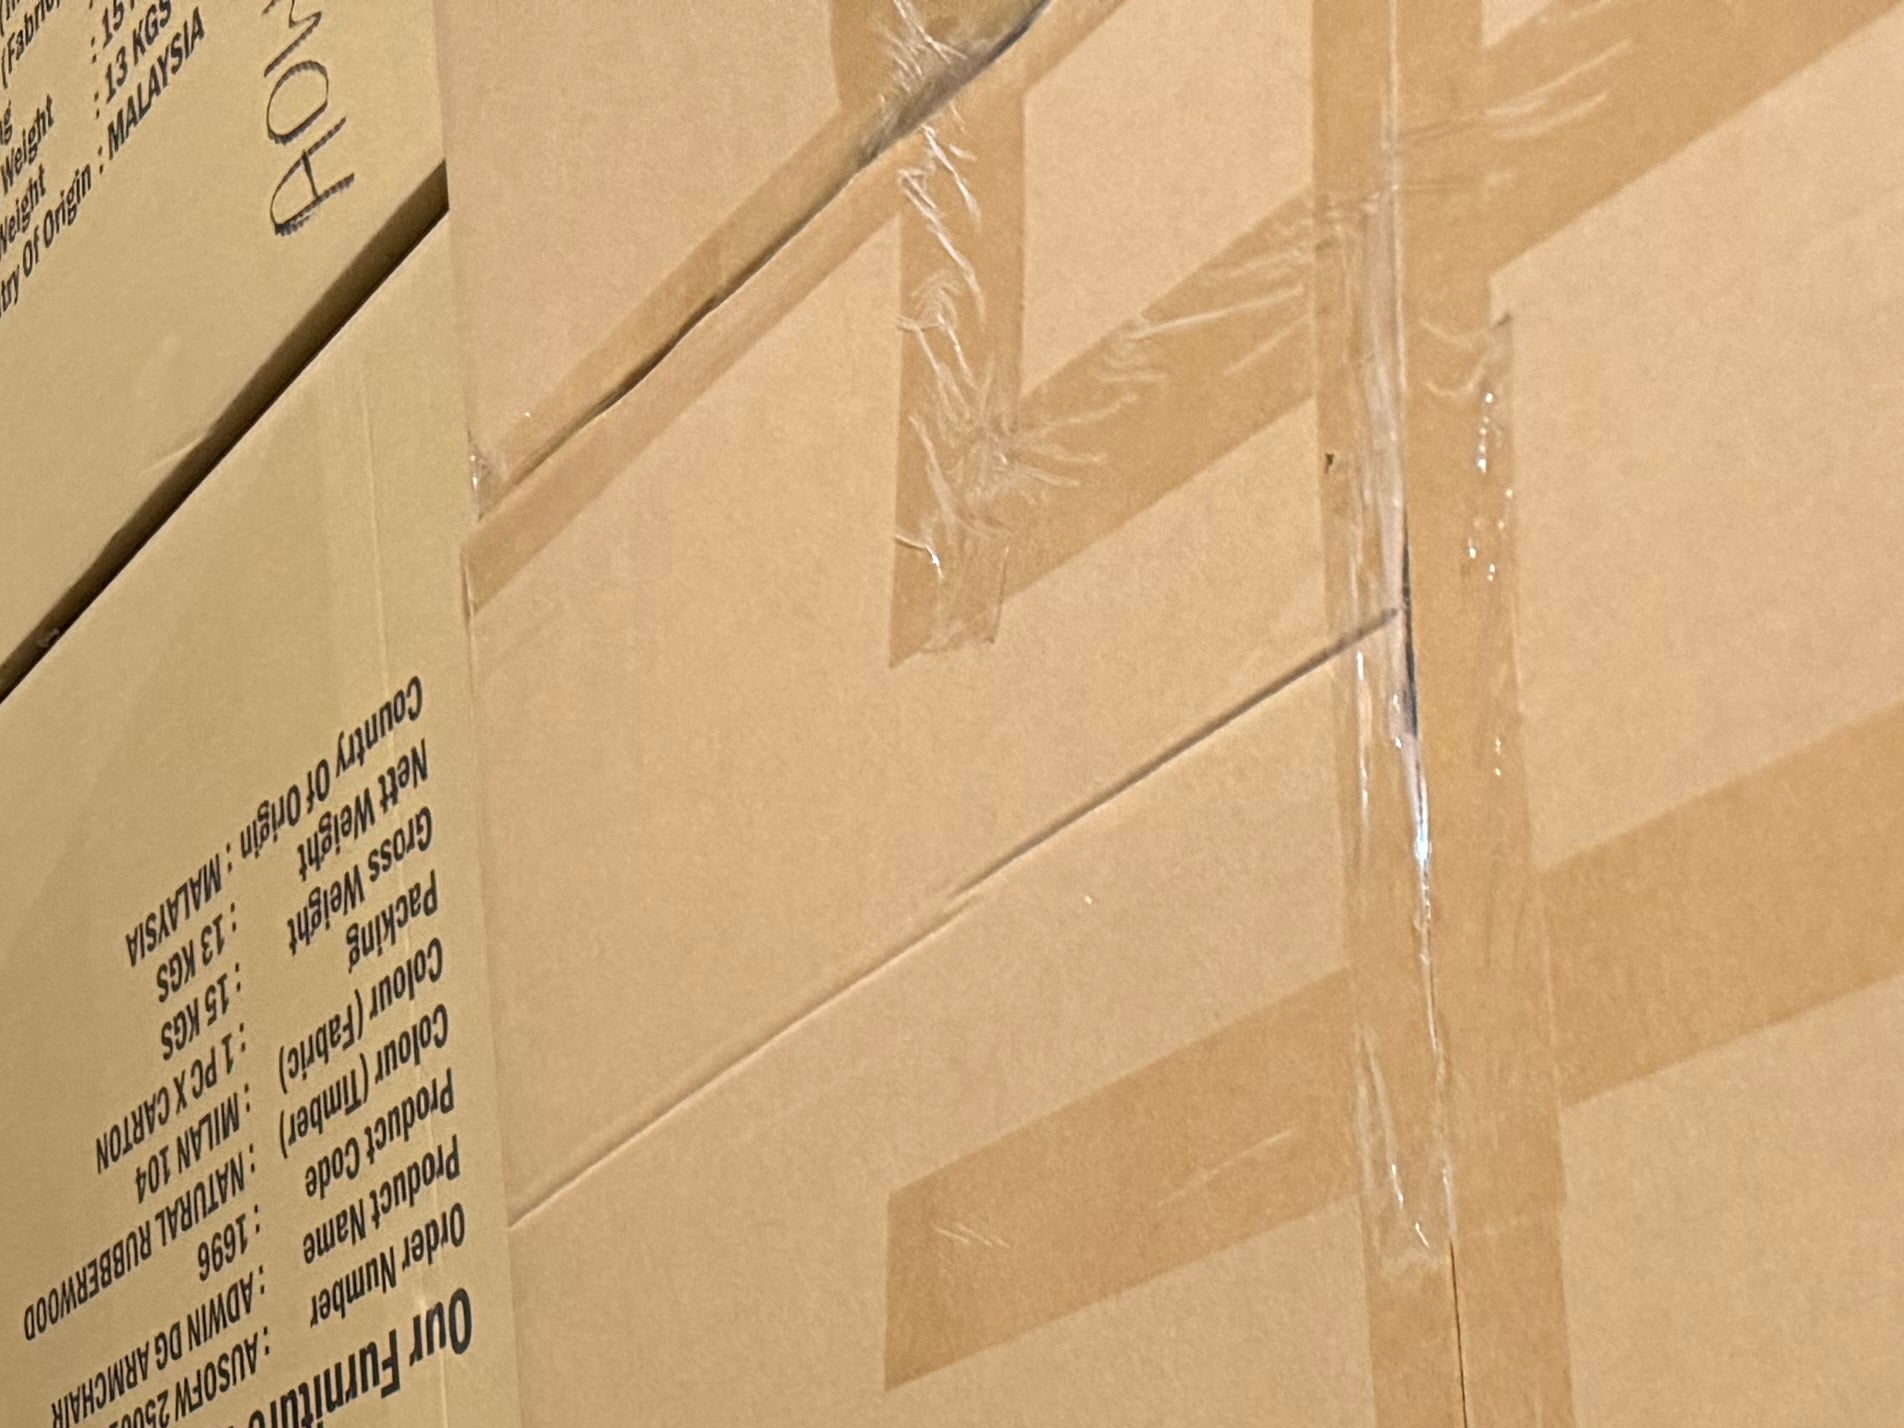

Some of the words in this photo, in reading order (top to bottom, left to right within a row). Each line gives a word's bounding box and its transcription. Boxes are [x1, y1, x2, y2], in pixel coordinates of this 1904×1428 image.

[105, 45, 128, 104] 13
[22, 225, 39, 278] Of
[42, 164, 91, 248] Origin
[107, 6, 205, 161] MALAYSIA
[367, 806, 432, 883] Gross
[287, 864, 365, 956] Weight
[345, 869, 438, 974] Packing
[204, 973, 230, 1027] 15
[369, 937, 443, 1020] Colour
[160, 997, 200, 1061] KGS
[221, 1032, 234, 1075] 1
[279, 988, 364, 1095] (Fabric)
[374, 1003, 448, 1085] Colour
[173, 1069, 188, 1116] X
[190, 1046, 218, 1100] PC
[279, 1052, 369, 1160] (Timber)
[96, 1086, 170, 1175] CARTON
[176, 1092, 240, 1174] MILAN
[135, 1144, 171, 1204] 104
[154, 1151, 245, 1247] NATURAL
[401, 1202, 465, 1272] Order
[24, 1220, 152, 1341] RUBBERWOOD
[310, 1246, 397, 1328] Number
[409, 1287, 472, 1367] Our
[175, 1332, 258, 1422] AUSOFW
